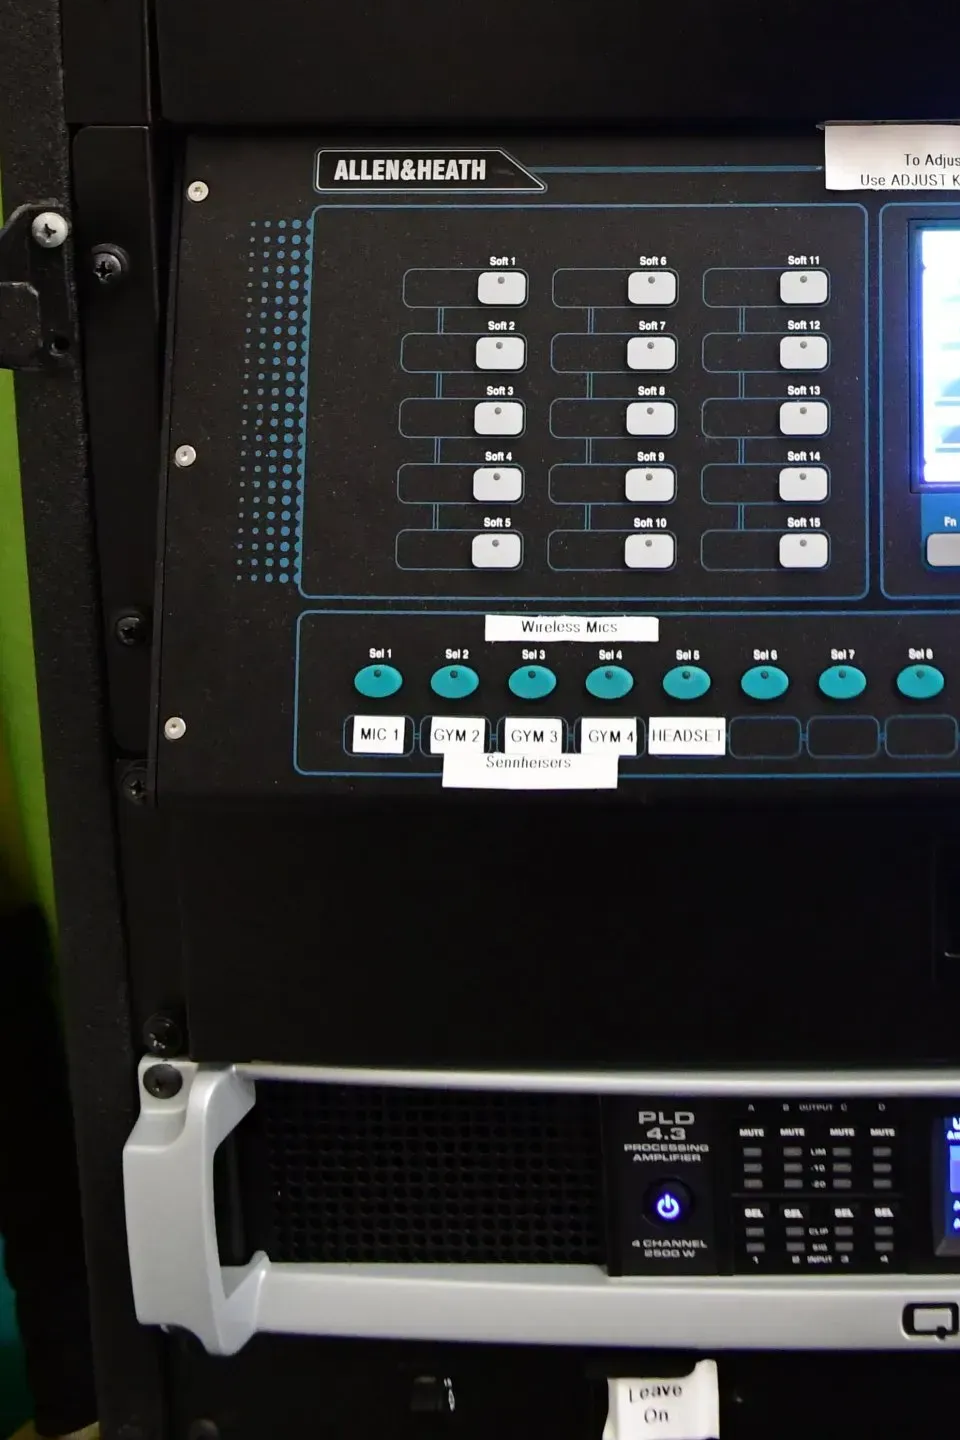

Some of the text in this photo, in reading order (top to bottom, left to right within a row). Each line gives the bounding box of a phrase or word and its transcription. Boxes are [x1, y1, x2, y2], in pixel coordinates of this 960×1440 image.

[904, 153, 920, 166] To
[334, 158, 486, 181] ALLEN&HEATH
[860, 174, 886, 187] Use
[891, 174, 946, 187] ADJUST
[489, 256, 516, 266] Soft 1
[639, 256, 667, 266] Soft 6
[787, 256, 820, 266] Soft 11
[487, 321, 516, 331] Soft 2
[486, 386, 514, 396] Soft 3
[944, 515, 957, 527] Fn
[521, 621, 618, 634] Wireless Mics
[360, 728, 399, 741] MIC 1
[434, 729, 480, 743] GYM 2
[510, 729, 558, 743] GYM 3
[588, 729, 634, 743] GYM 4
[651, 729, 721, 743] HEADSET
[485, 755, 572, 769] Sennheisers
[638, 1110, 696, 1126] PLD
[646, 1127, 687, 1141] 4.3
[623, 1143, 710, 1153] PROCESSING
[632, 1153, 702, 1163] AMPLIFIER
[642, 1239, 708, 1248] CHANNEL
[629, 1384, 684, 1404] Leave
[644, 1408, 669, 1424] On
